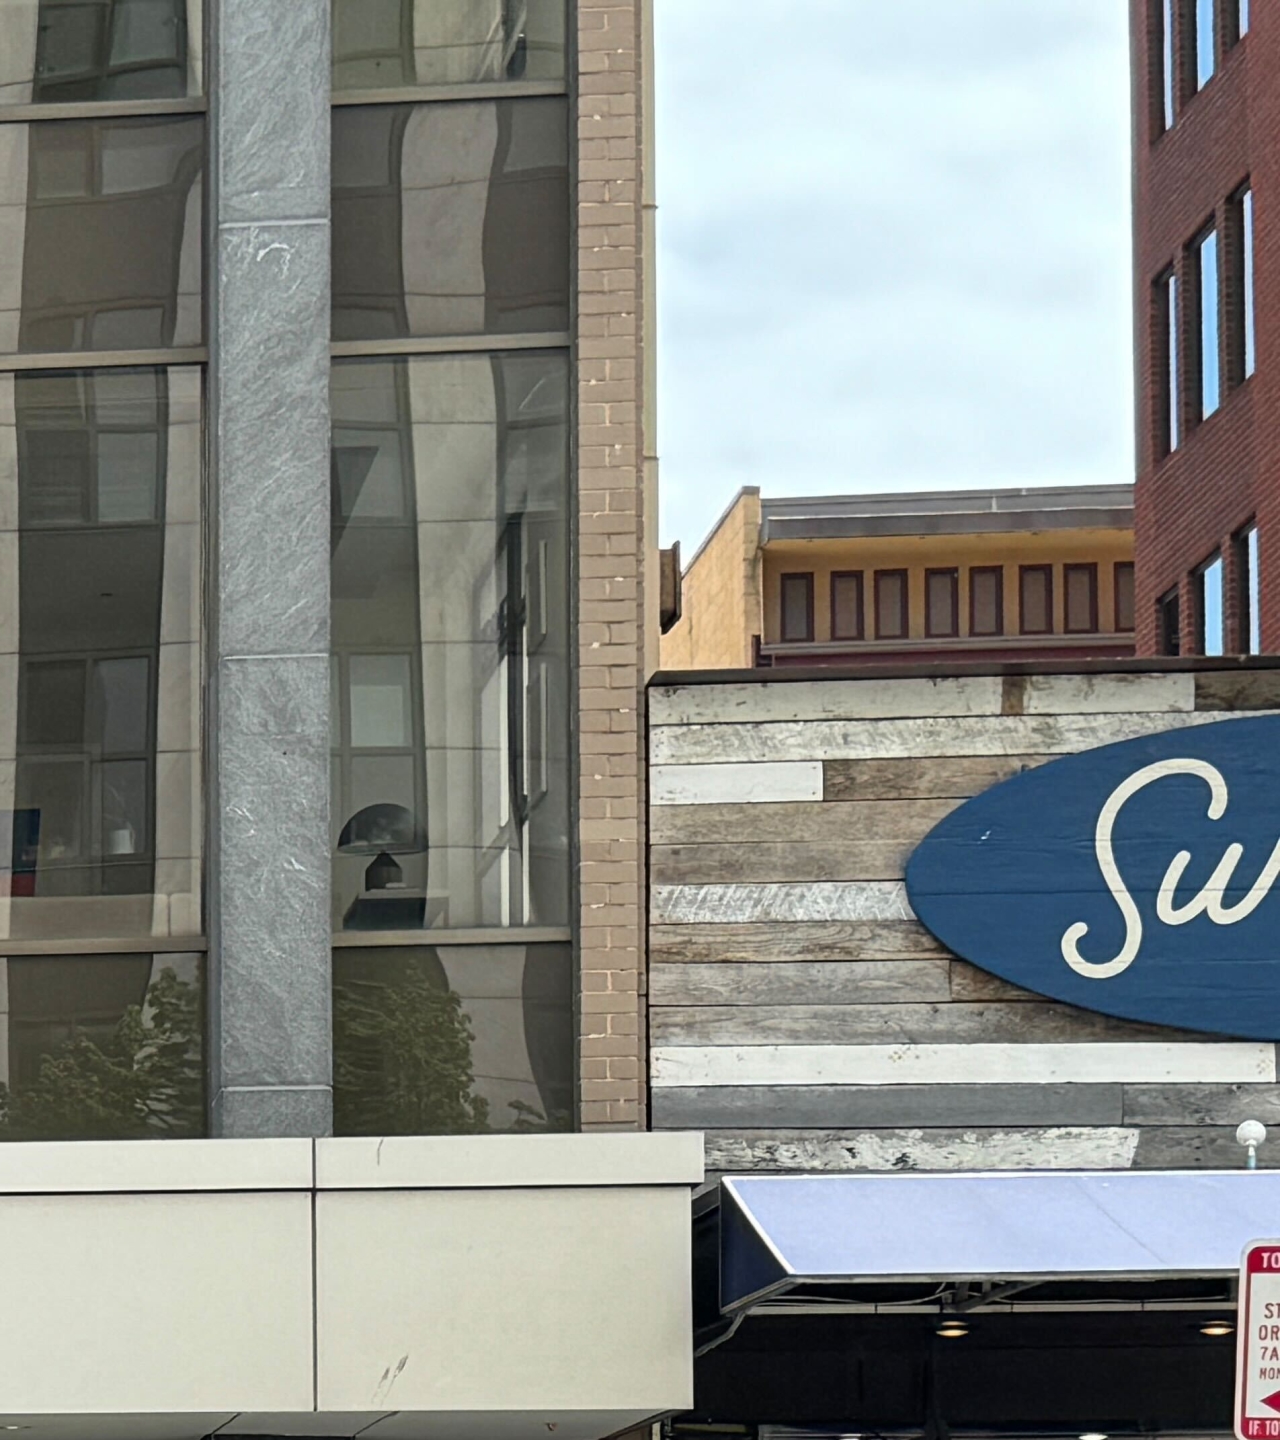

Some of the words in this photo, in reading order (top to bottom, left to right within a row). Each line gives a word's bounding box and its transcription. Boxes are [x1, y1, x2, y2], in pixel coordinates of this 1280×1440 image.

[1261, 1252, 1280, 1268] TO
[1259, 1325, 1280, 1341] OR
[1260, 1346, 1280, 1361] 7A
[1248, 1420, 1261, 1435] IF
[1265, 1420, 1280, 1435] TO
